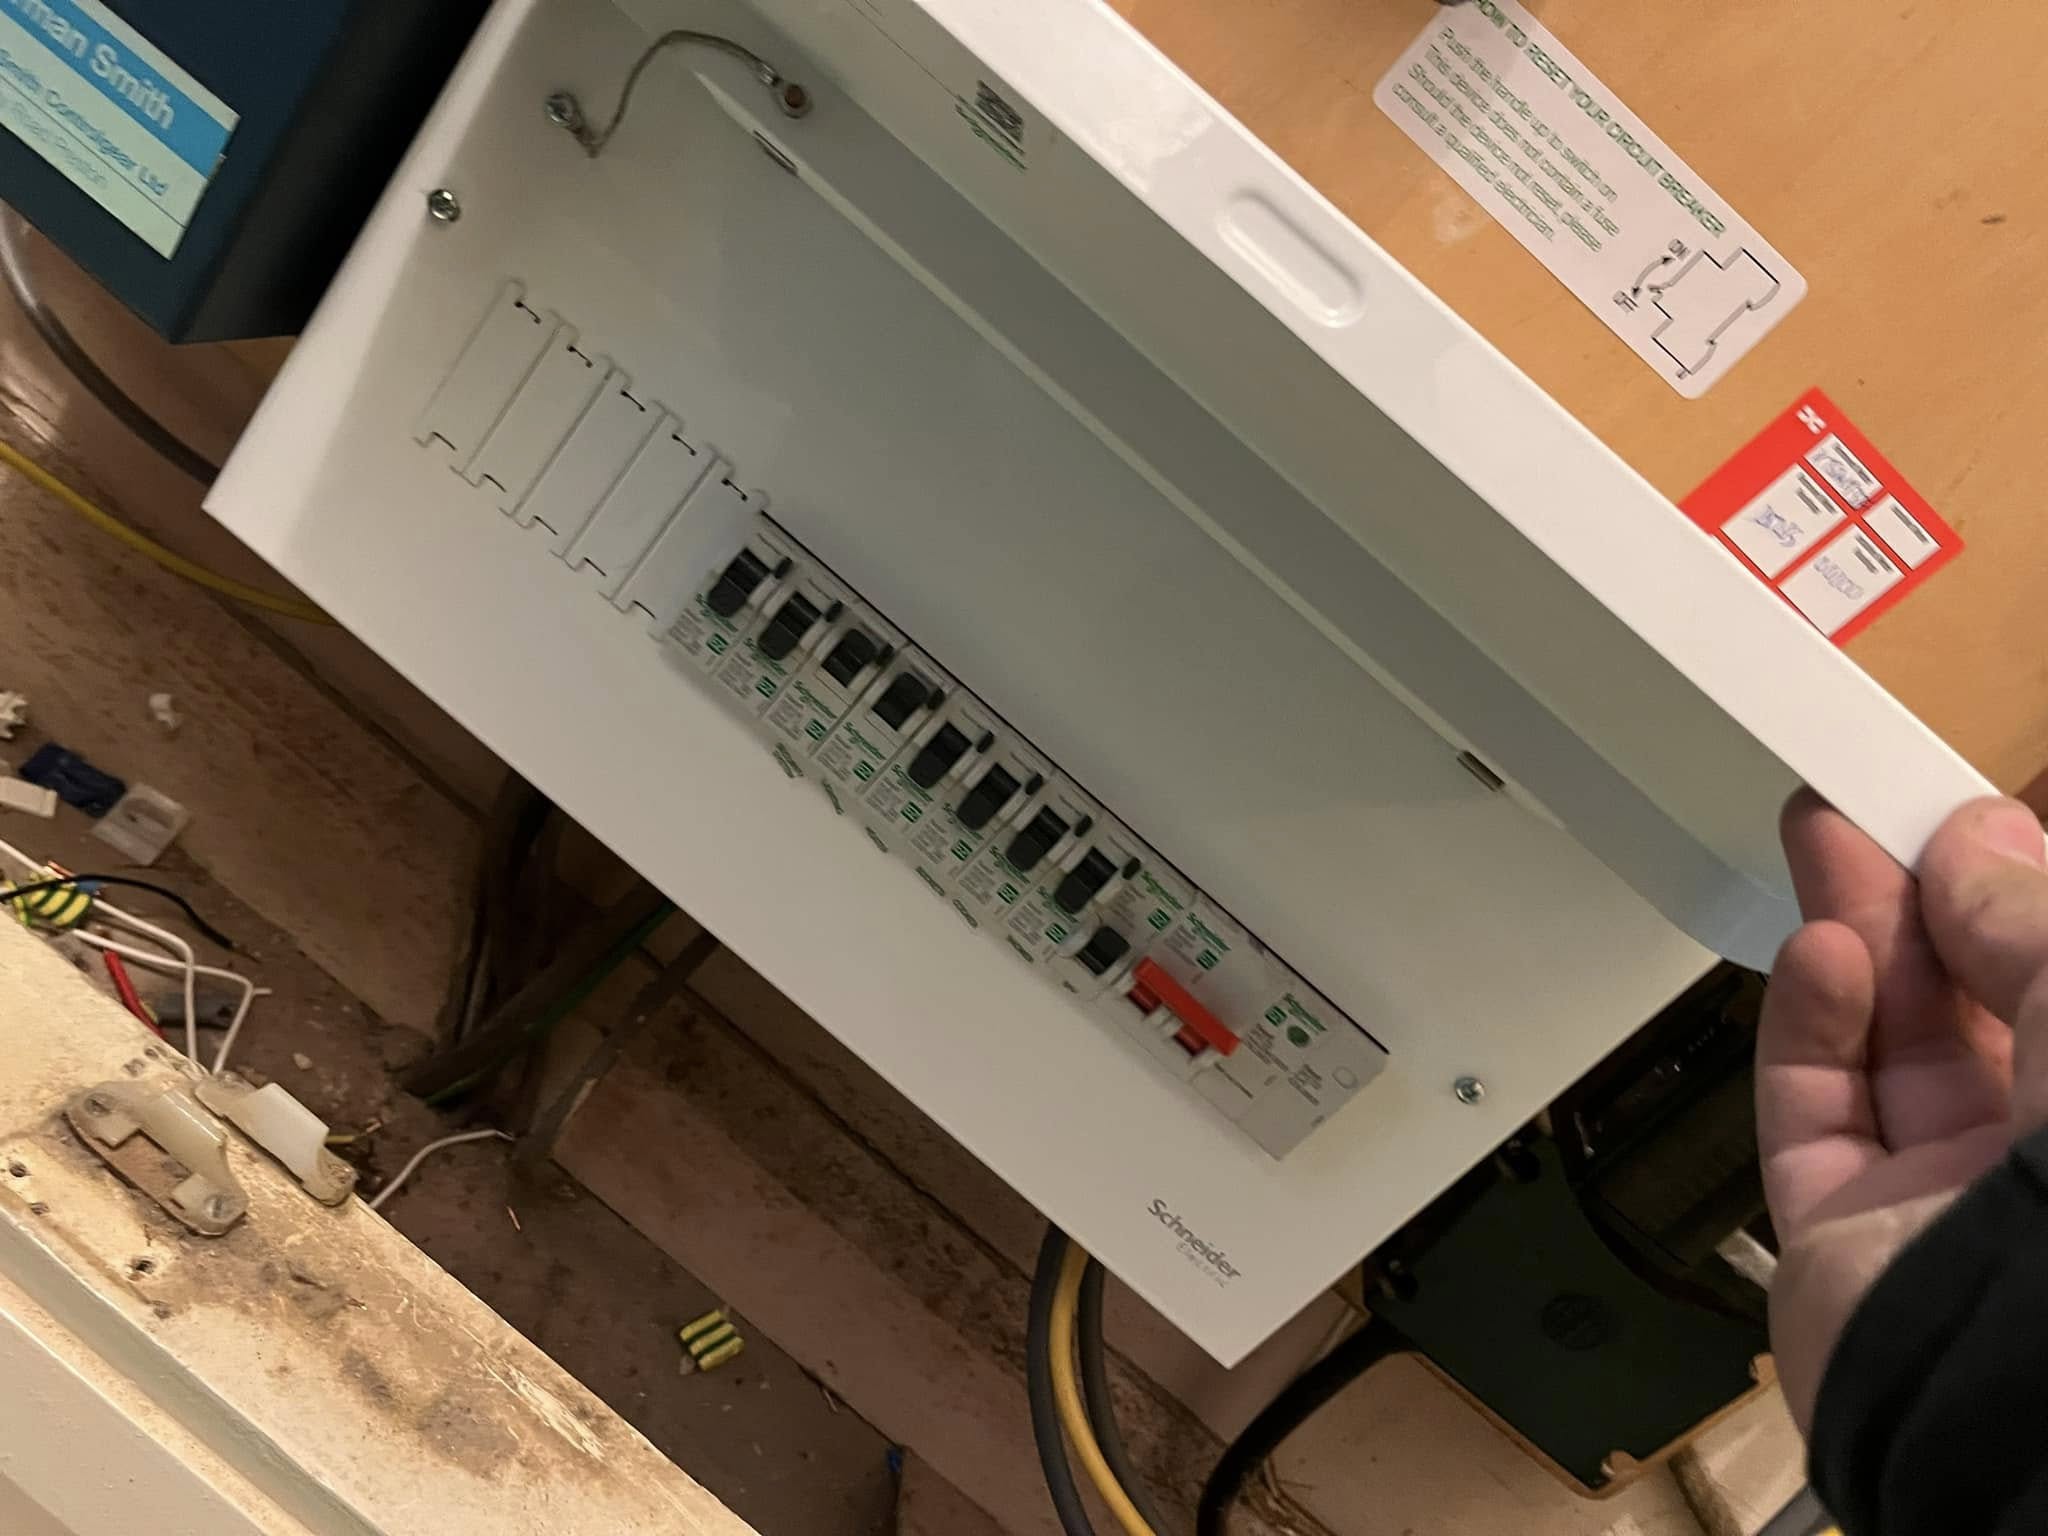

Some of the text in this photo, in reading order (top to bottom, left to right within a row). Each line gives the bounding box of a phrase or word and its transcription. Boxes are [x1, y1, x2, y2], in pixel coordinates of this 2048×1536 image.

[91, 43, 175, 129] Smith
[1392, 83, 1438, 125] consult
[1434, 124, 1447, 136] a
[1445, 134, 1498, 184] qualified
[1425, 44, 1451, 76] This
[1450, 72, 1490, 114] device
[1488, 109, 1519, 143] does
[1519, 139, 1542, 161] not
[1540, 159, 1583, 201] contain
[1591, 206, 1620, 237] fuse
[1439, 26, 1618, 202] Push the handle up to switch on
[1505, 23, 1528, 48] TO
[1523, 42, 1572, 89] RESET
[1568, 84, 1610, 127] YOUR
[1606, 122, 1663, 176] CIRCUIT
[1658, 172, 1726, 239] BREAKER
[138, 166, 169, 196] Ltd
[1408, 63, 1455, 108] Should
[1449, 102, 1473, 128] the
[1468, 123, 1510, 166] device
[1509, 161, 1533, 184] not
[1560, 211, 1602, 253] please
[1147, 1197, 1242, 1280] Schneider
